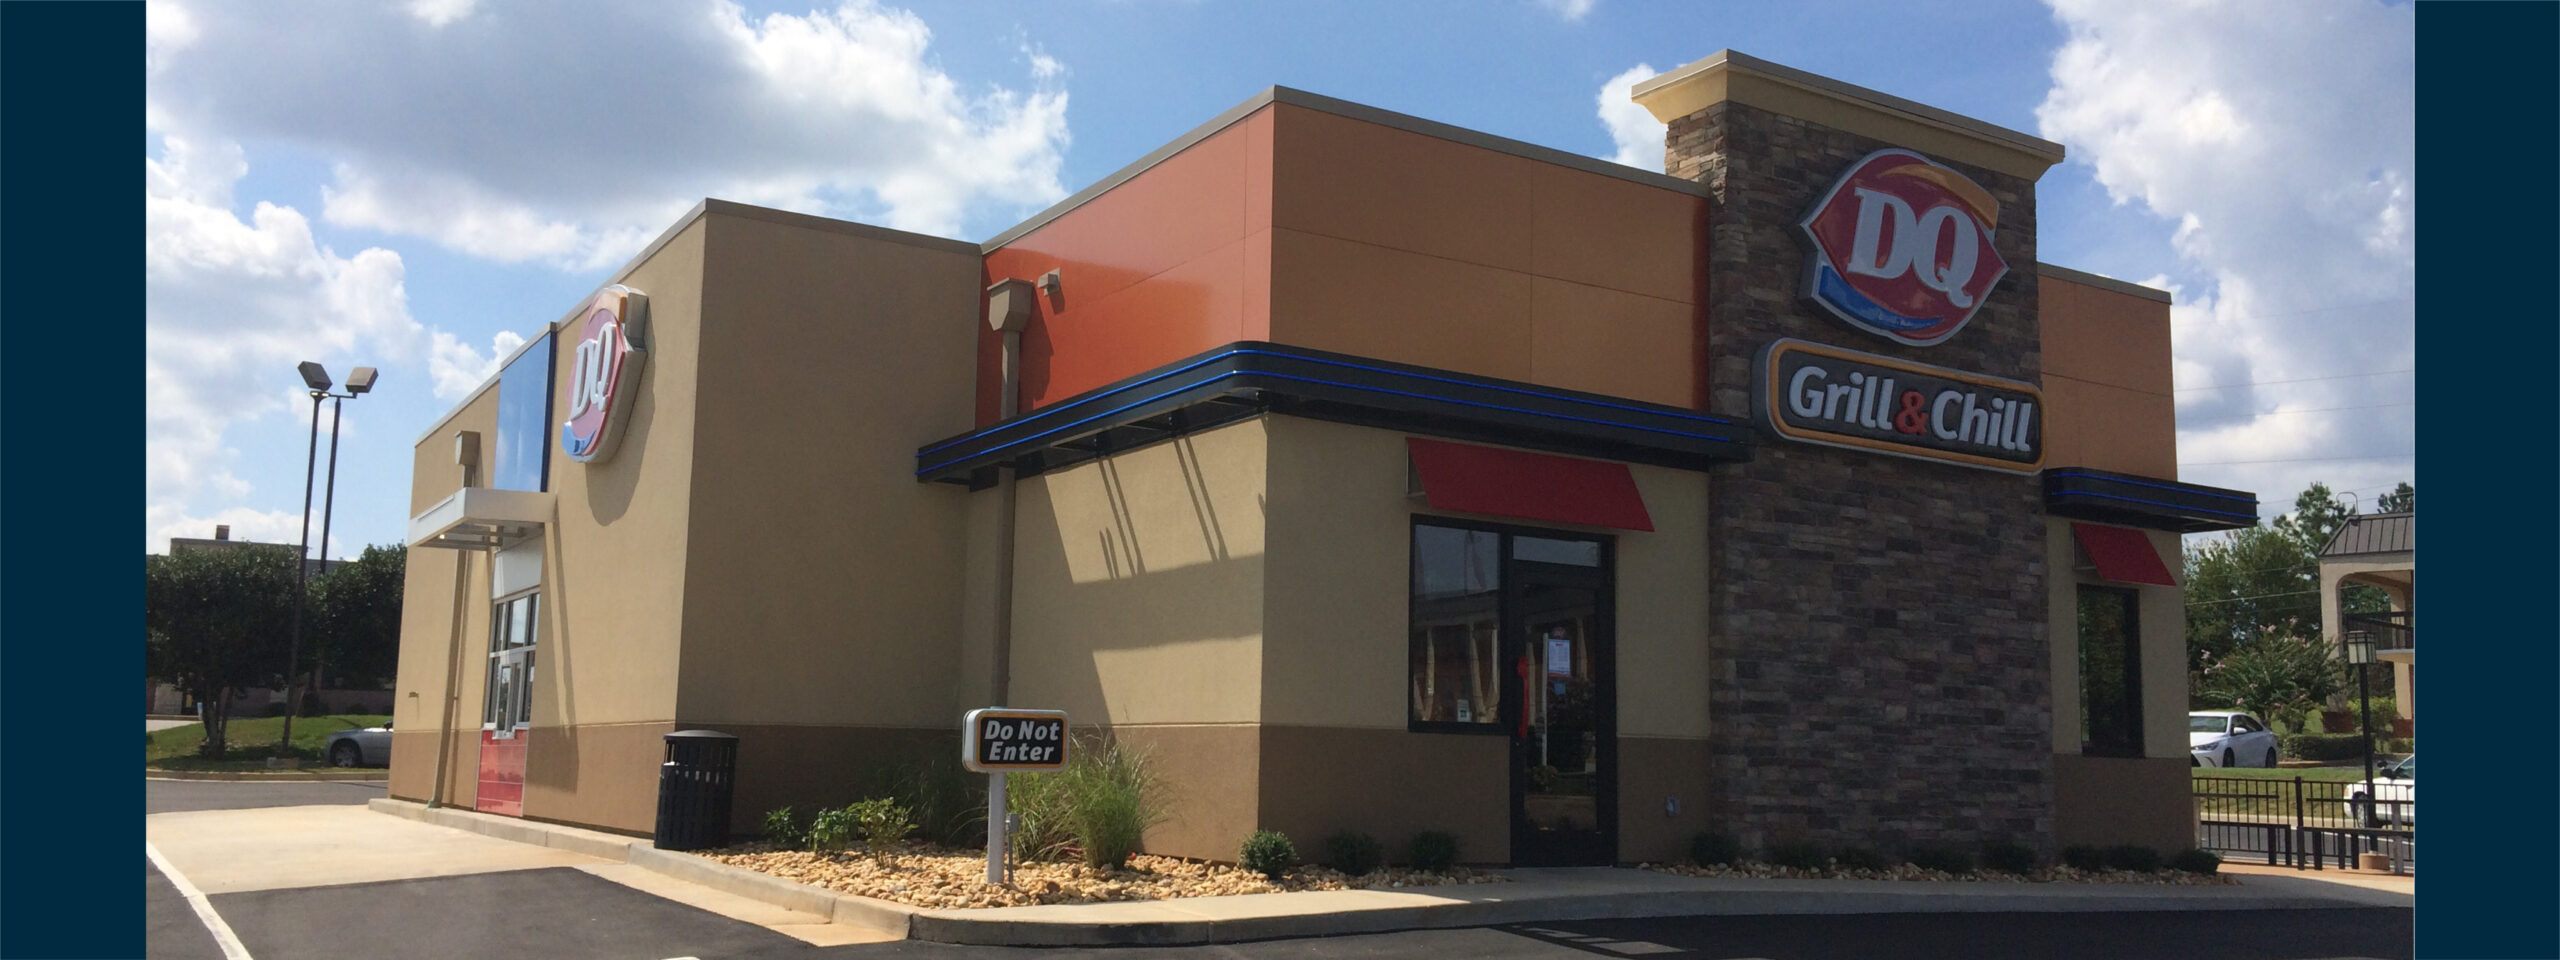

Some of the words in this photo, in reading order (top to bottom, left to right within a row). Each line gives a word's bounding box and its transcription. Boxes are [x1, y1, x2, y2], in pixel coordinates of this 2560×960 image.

[1847, 187, 1979, 309] DQ
[571, 322, 616, 420] DQ
[984, 720, 1014, 740] Do
[1018, 720, 1060, 741] Not
[989, 741, 1055, 761] Enter
